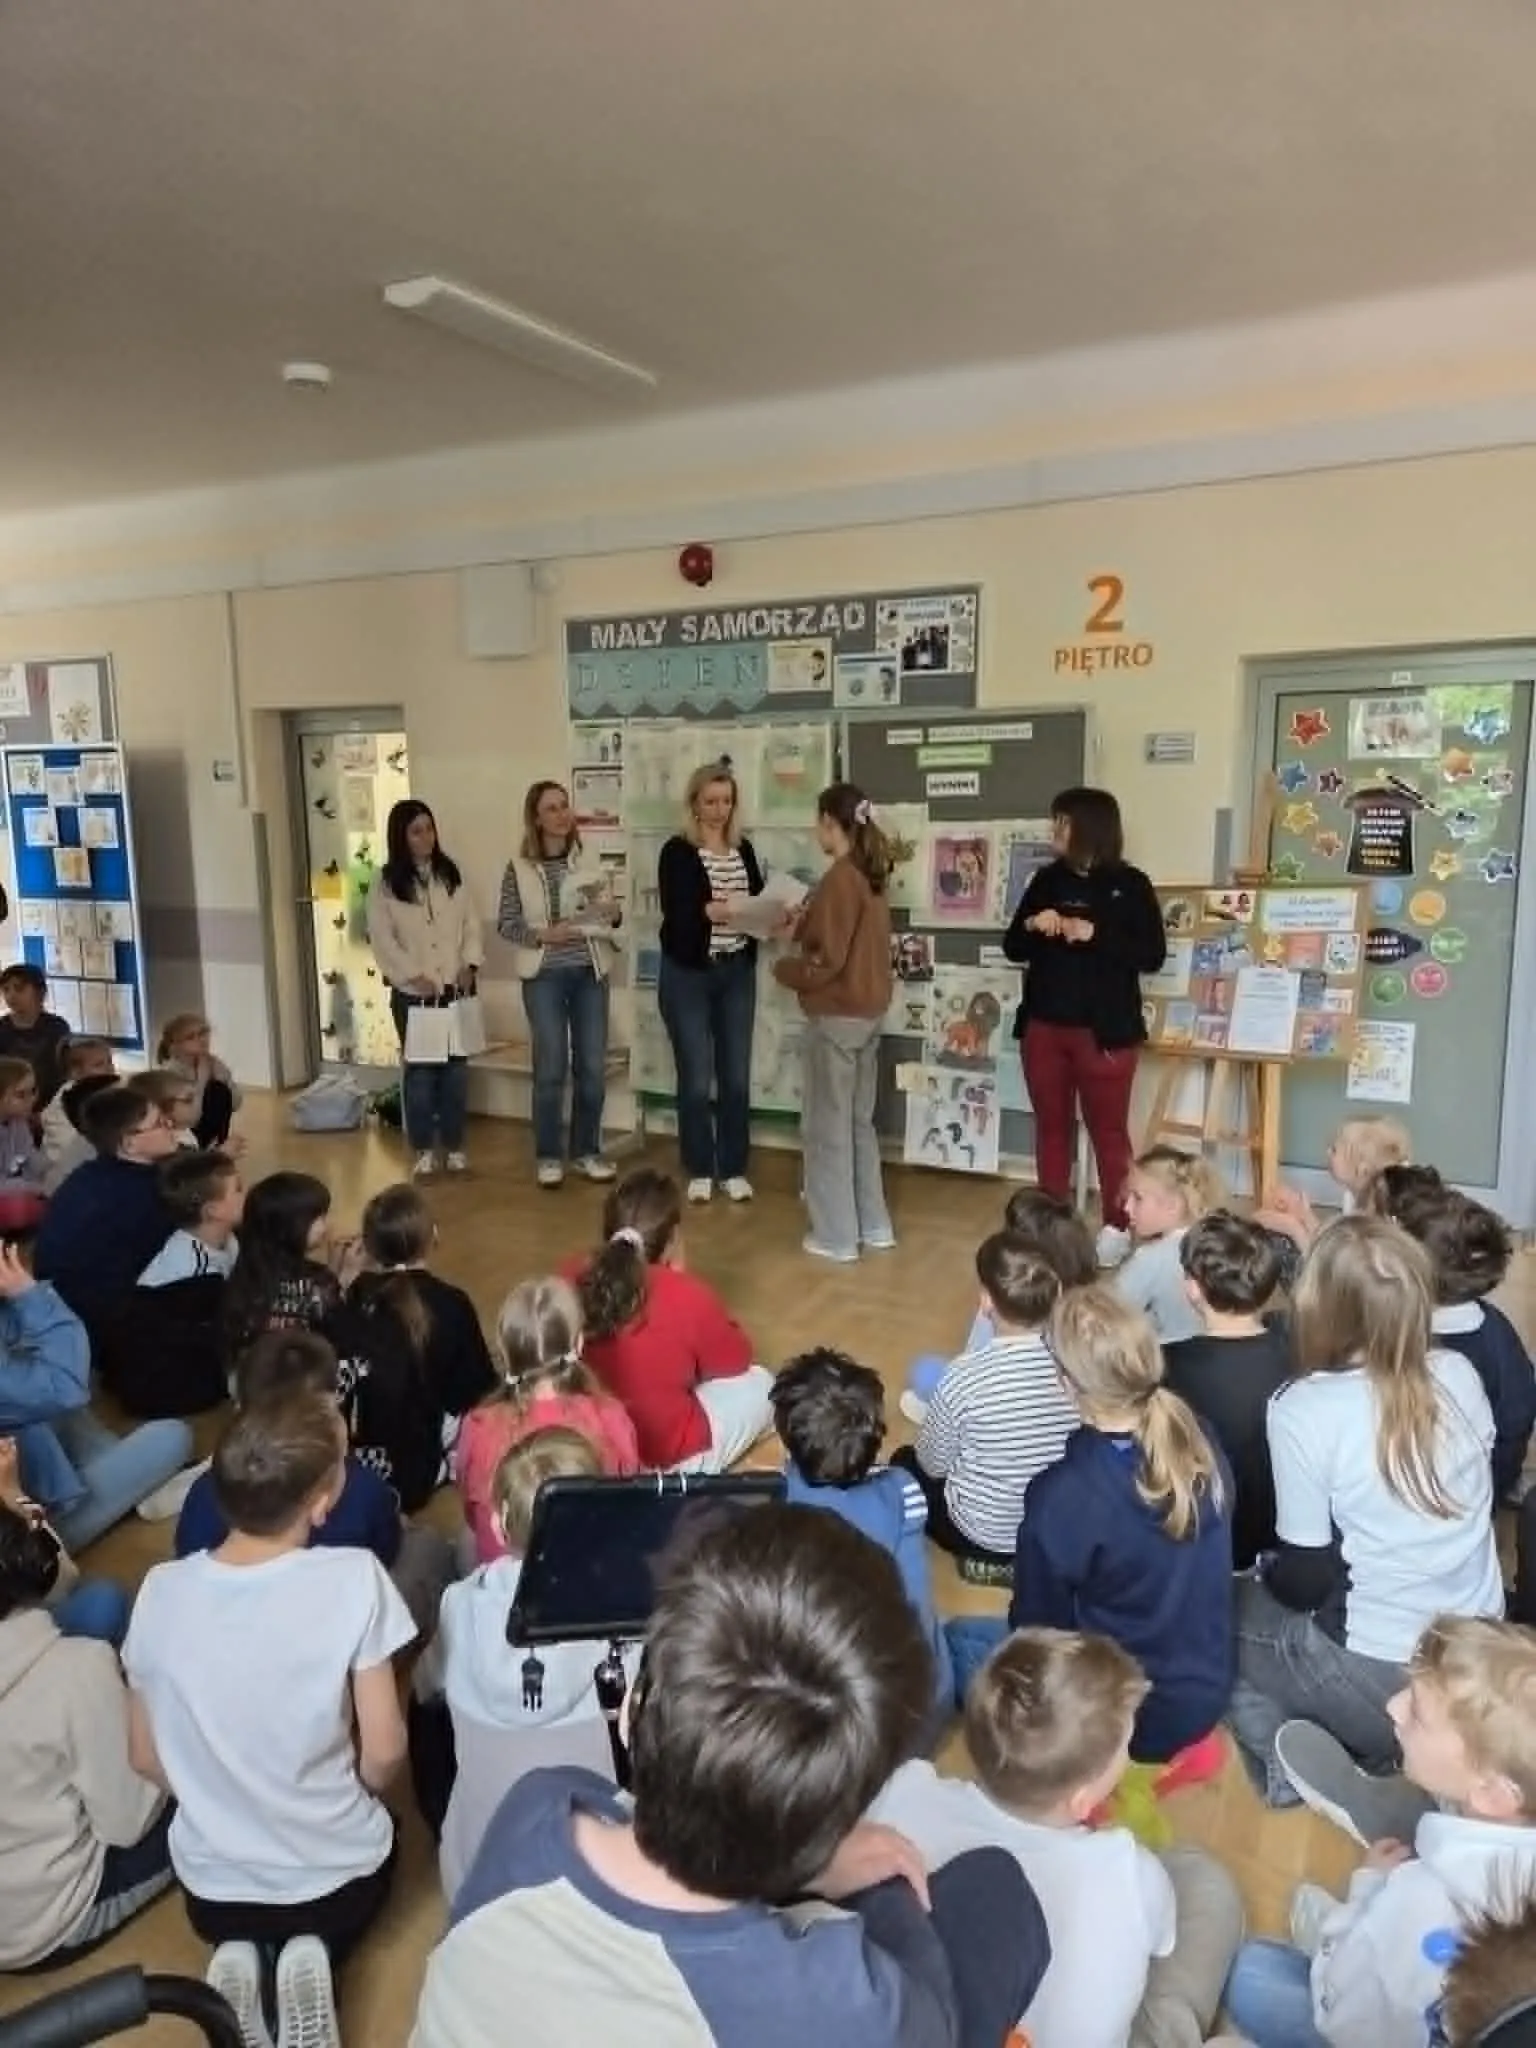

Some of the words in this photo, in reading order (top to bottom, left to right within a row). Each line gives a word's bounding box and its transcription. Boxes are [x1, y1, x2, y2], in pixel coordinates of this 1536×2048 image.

[680, 601, 865, 642] SAMORZĄD
[1085, 576, 1124, 632] 2
[1054, 643, 1153, 677] PIĘTRO
